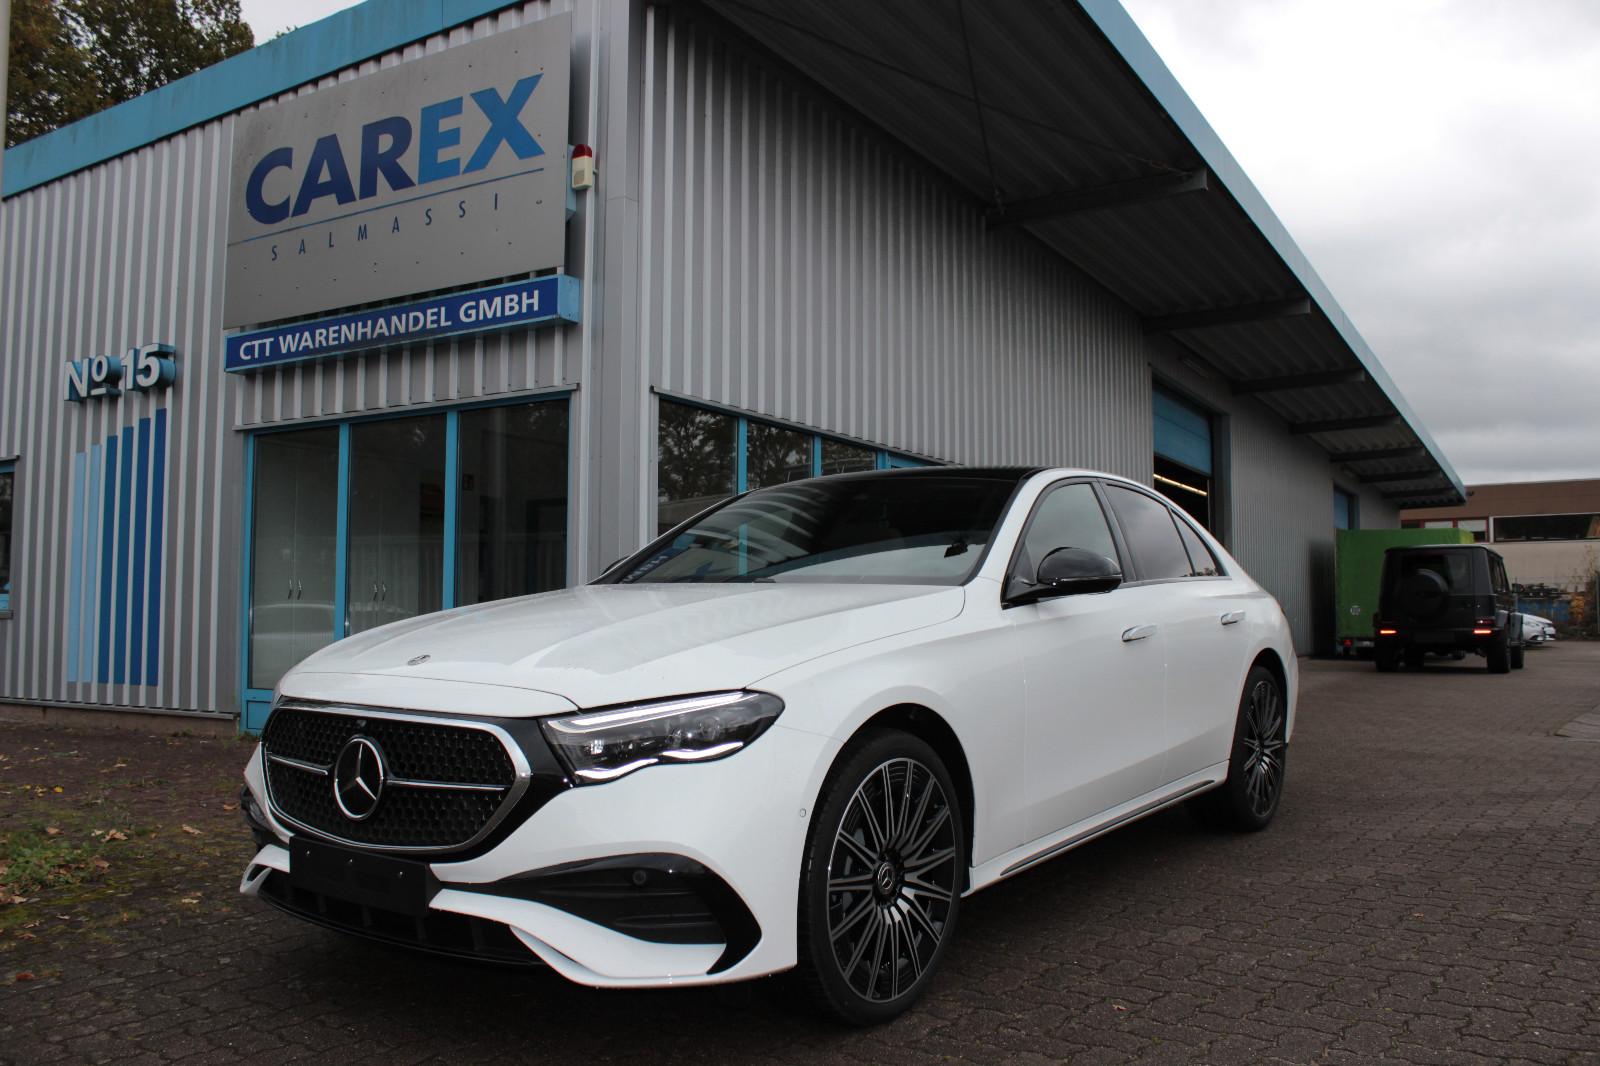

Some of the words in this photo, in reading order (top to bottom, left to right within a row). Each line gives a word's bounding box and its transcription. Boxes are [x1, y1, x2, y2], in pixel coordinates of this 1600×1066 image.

[246, 73, 545, 225] CAREX
[271, 192, 499, 262] SALMASSI
[239, 338, 274, 361] CTT
[279, 319, 452, 352] WARENHANDEL
[459, 290, 540, 323] GMBH
[121, 343, 161, 390] 15
